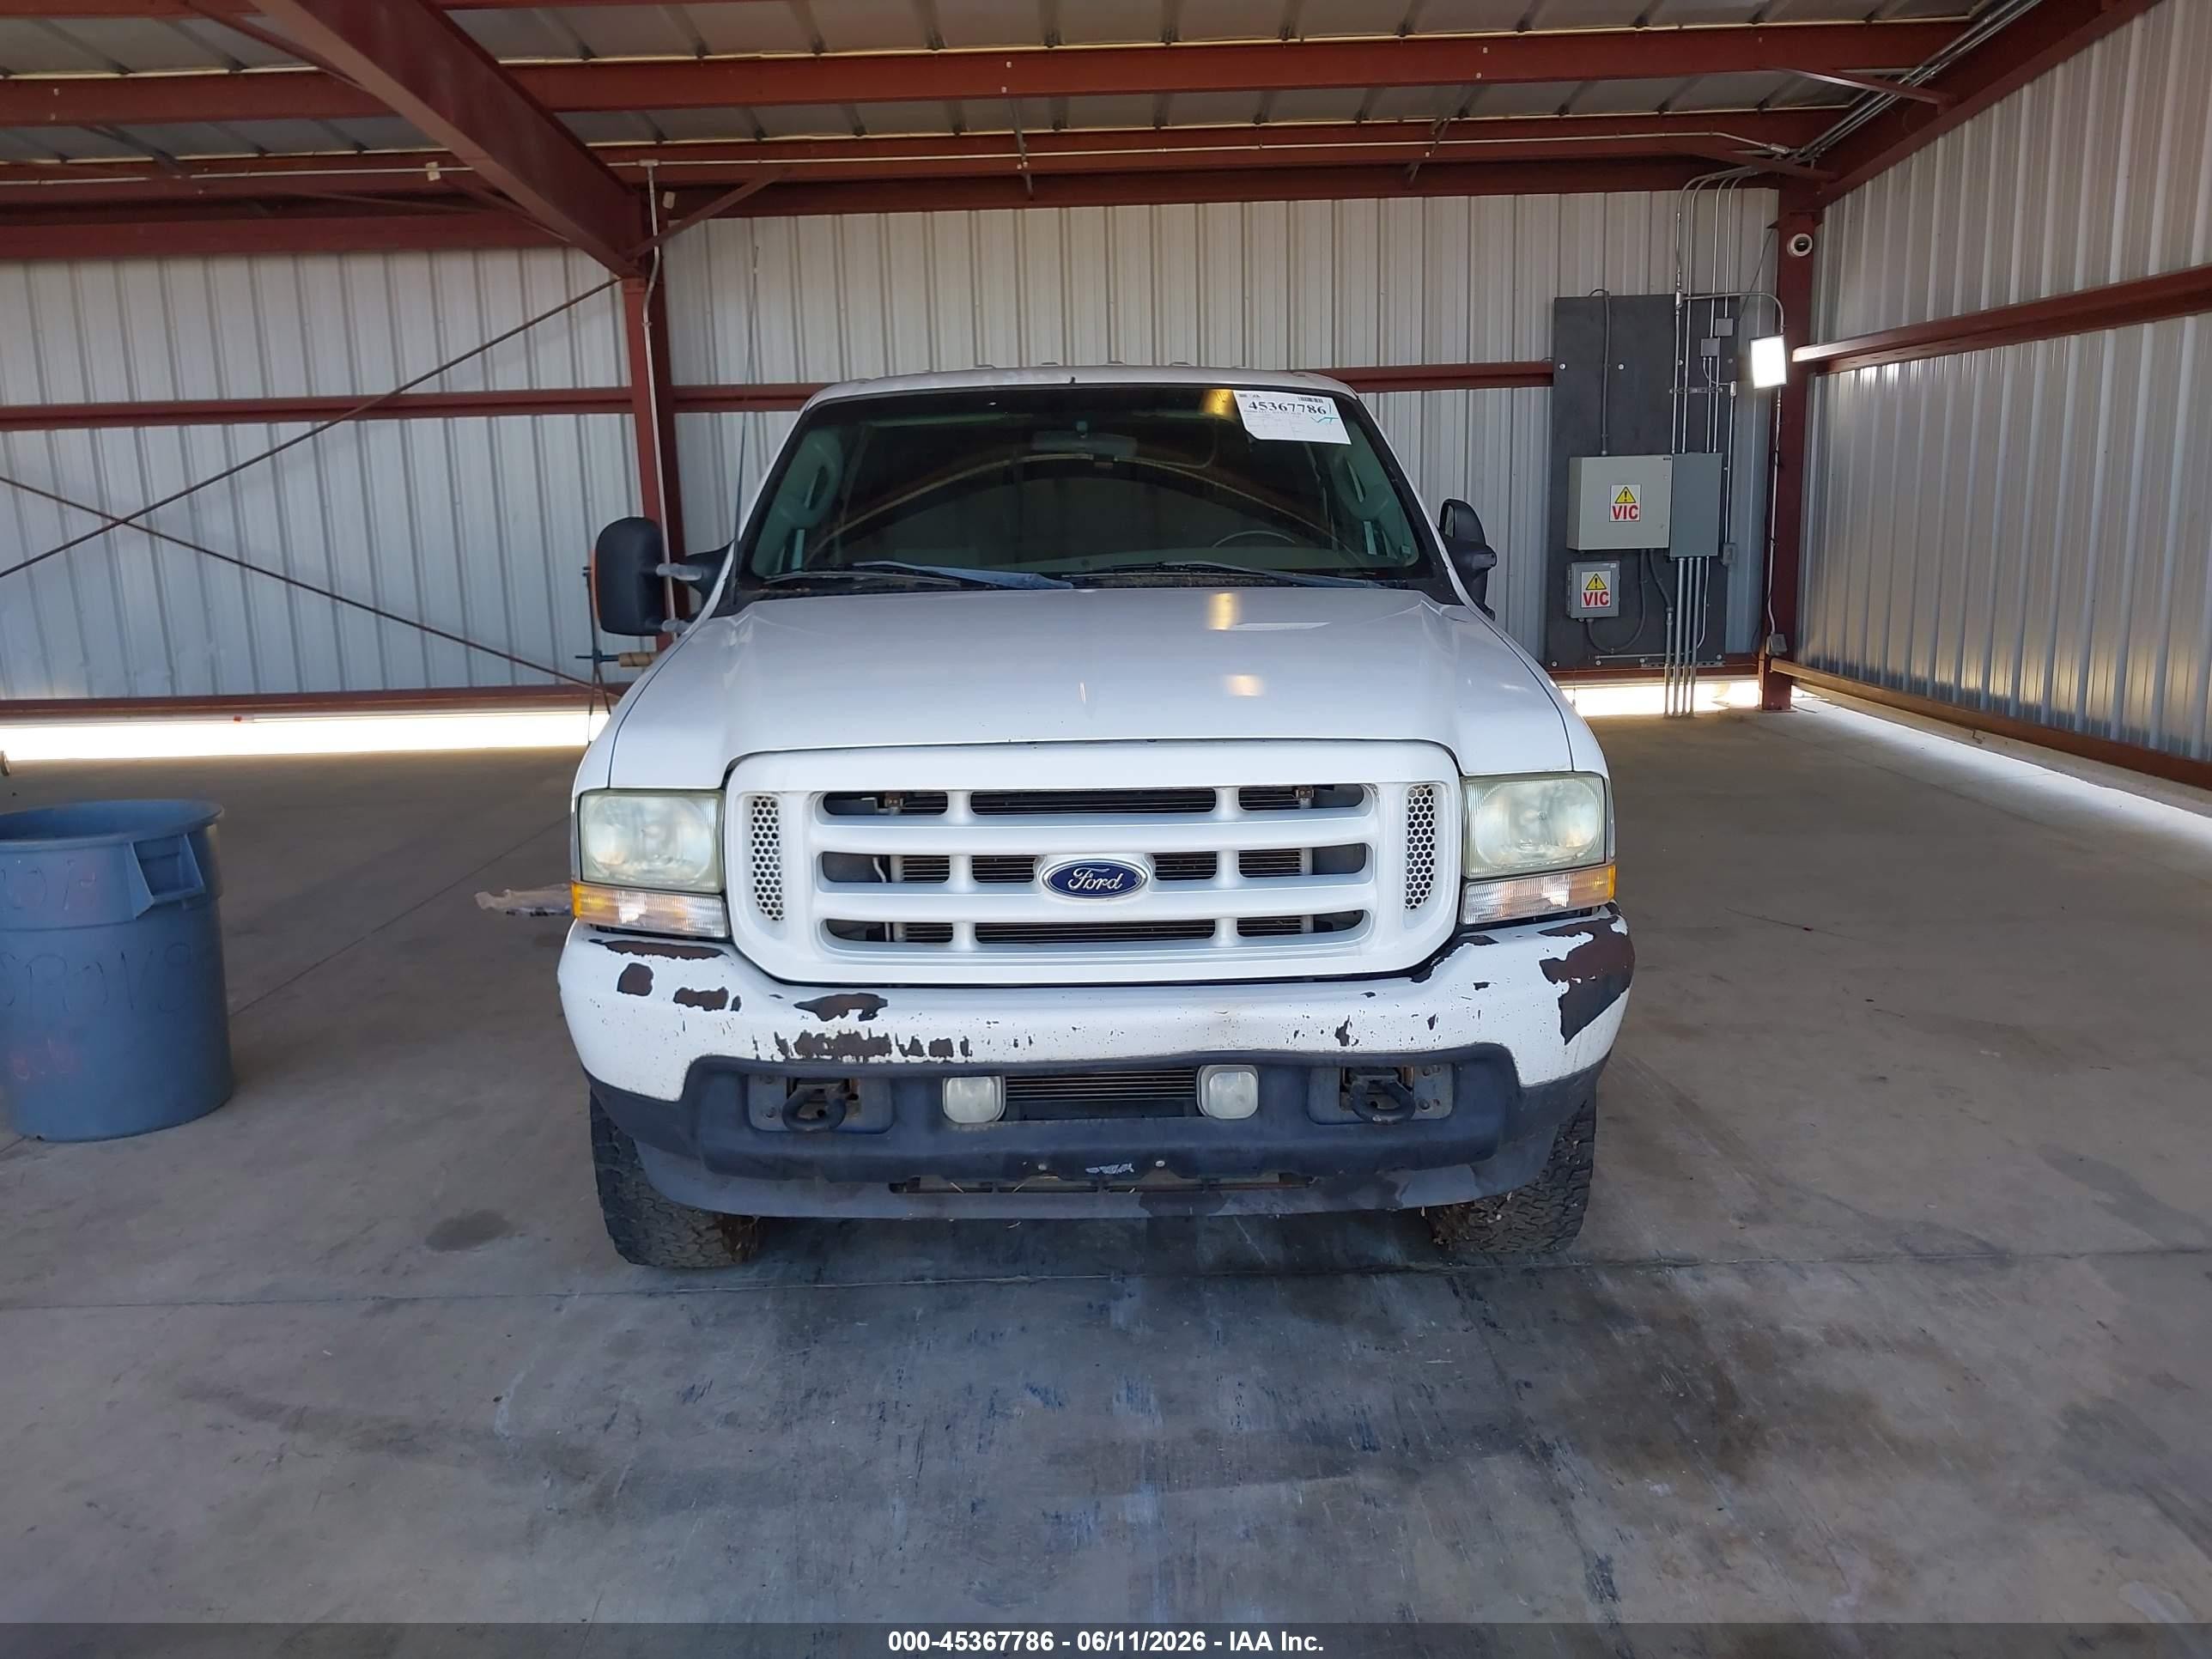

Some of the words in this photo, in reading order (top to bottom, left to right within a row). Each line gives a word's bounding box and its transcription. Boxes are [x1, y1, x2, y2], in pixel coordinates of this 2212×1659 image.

[1248, 400, 1328, 415] 45367786
[1612, 504, 1639, 520] VIC
[1583, 591, 1609, 606] VIC
[1067, 866, 1124, 890] Ford
